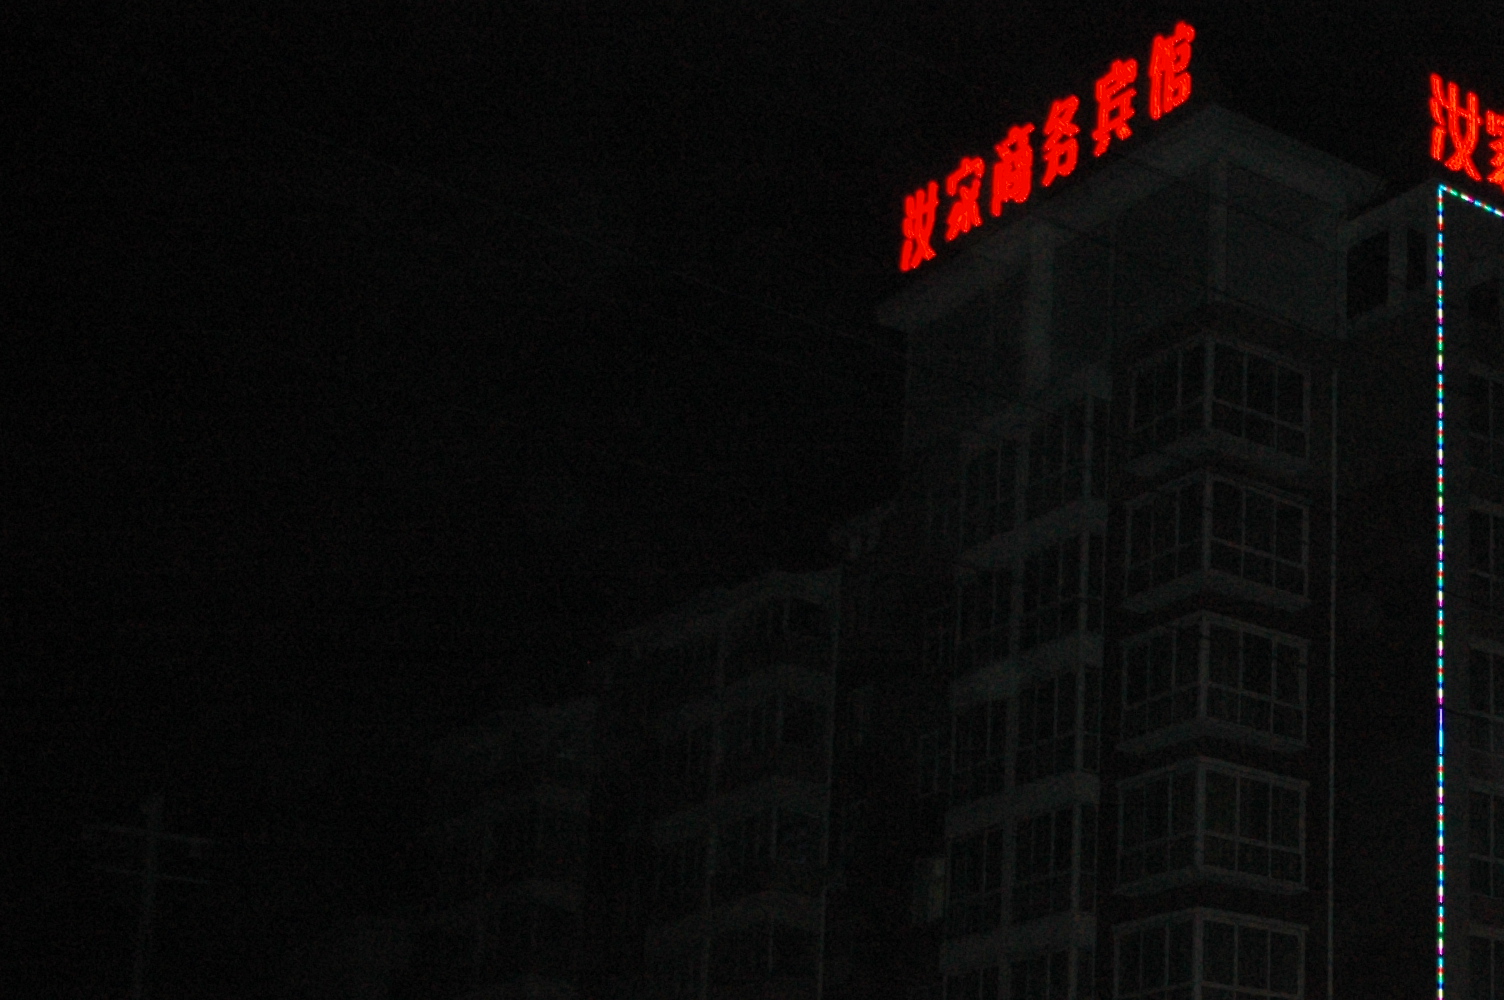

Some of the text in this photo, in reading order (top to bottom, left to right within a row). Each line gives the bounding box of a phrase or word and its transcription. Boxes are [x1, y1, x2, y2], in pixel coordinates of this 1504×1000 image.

[899, 21, 1196, 272] 汝家商务宾馆
